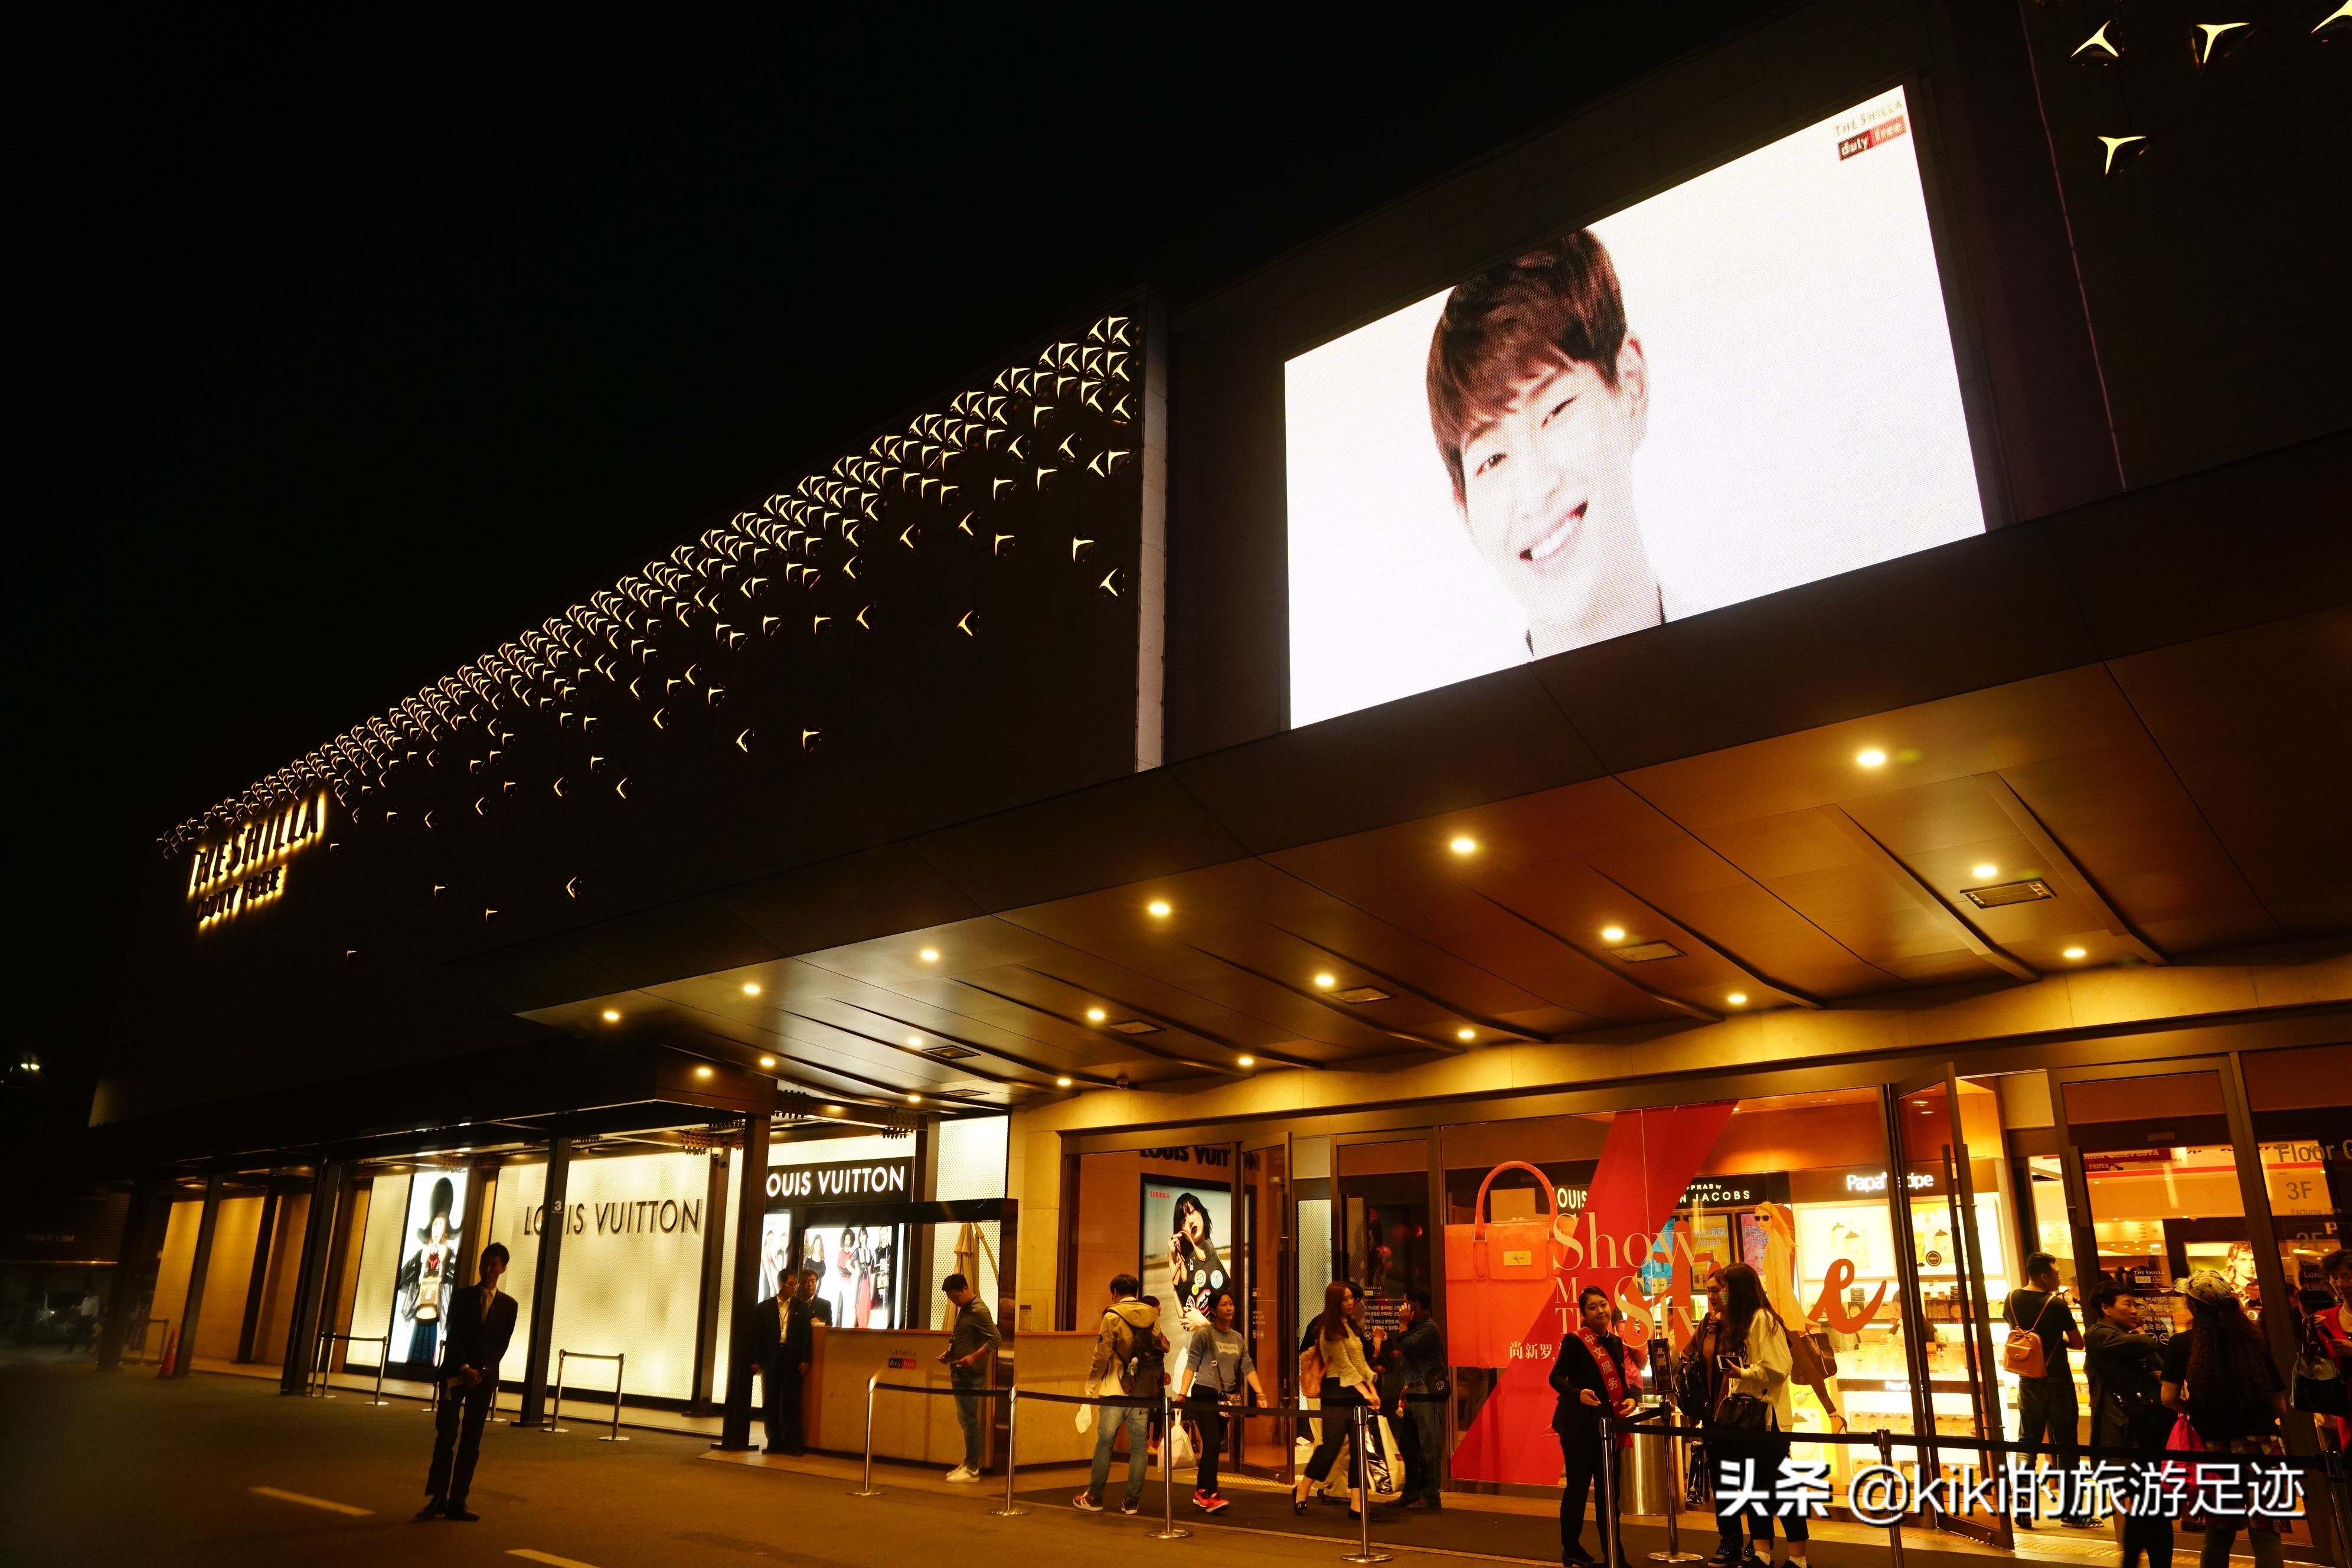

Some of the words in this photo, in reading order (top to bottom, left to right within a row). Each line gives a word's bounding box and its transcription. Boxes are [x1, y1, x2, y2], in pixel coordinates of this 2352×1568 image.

[1841, 136, 1868, 156] duty
[1874, 122, 1903, 141] free
[226, 792, 325, 874] SHILLA
[195, 884, 241, 925] DUTY
[239, 865, 286, 906] FREE
[2277, 1142, 2334, 1162] Floor
[766, 1171, 812, 1198] OUIS
[818, 1165, 905, 1195] VUITTON
[1847, 1174, 1886, 1193] Papa
[2285, 1181, 2312, 1200] 3F
[554, 1200, 563, 1211] 3
[1552, 1187, 1587, 1210] OUIS
[1692, 1190, 1750, 1202] JACOBS
[524, 1203, 585, 1236] LOIS
[595, 1198, 703, 1236] VUITTON
[1553, 1212, 1701, 1270] Show
[2295, 1231, 2323, 1250] 2F
[1554, 1276, 1579, 1304] M
[899, 1348, 916, 1357] SHILLA
[1509, 1340, 1562, 1362] 尚新罗,
[1584, 1333, 1618, 1391] 中文服务
[889, 1359, 901, 1368] duty
[903, 1360, 915, 1368] free
